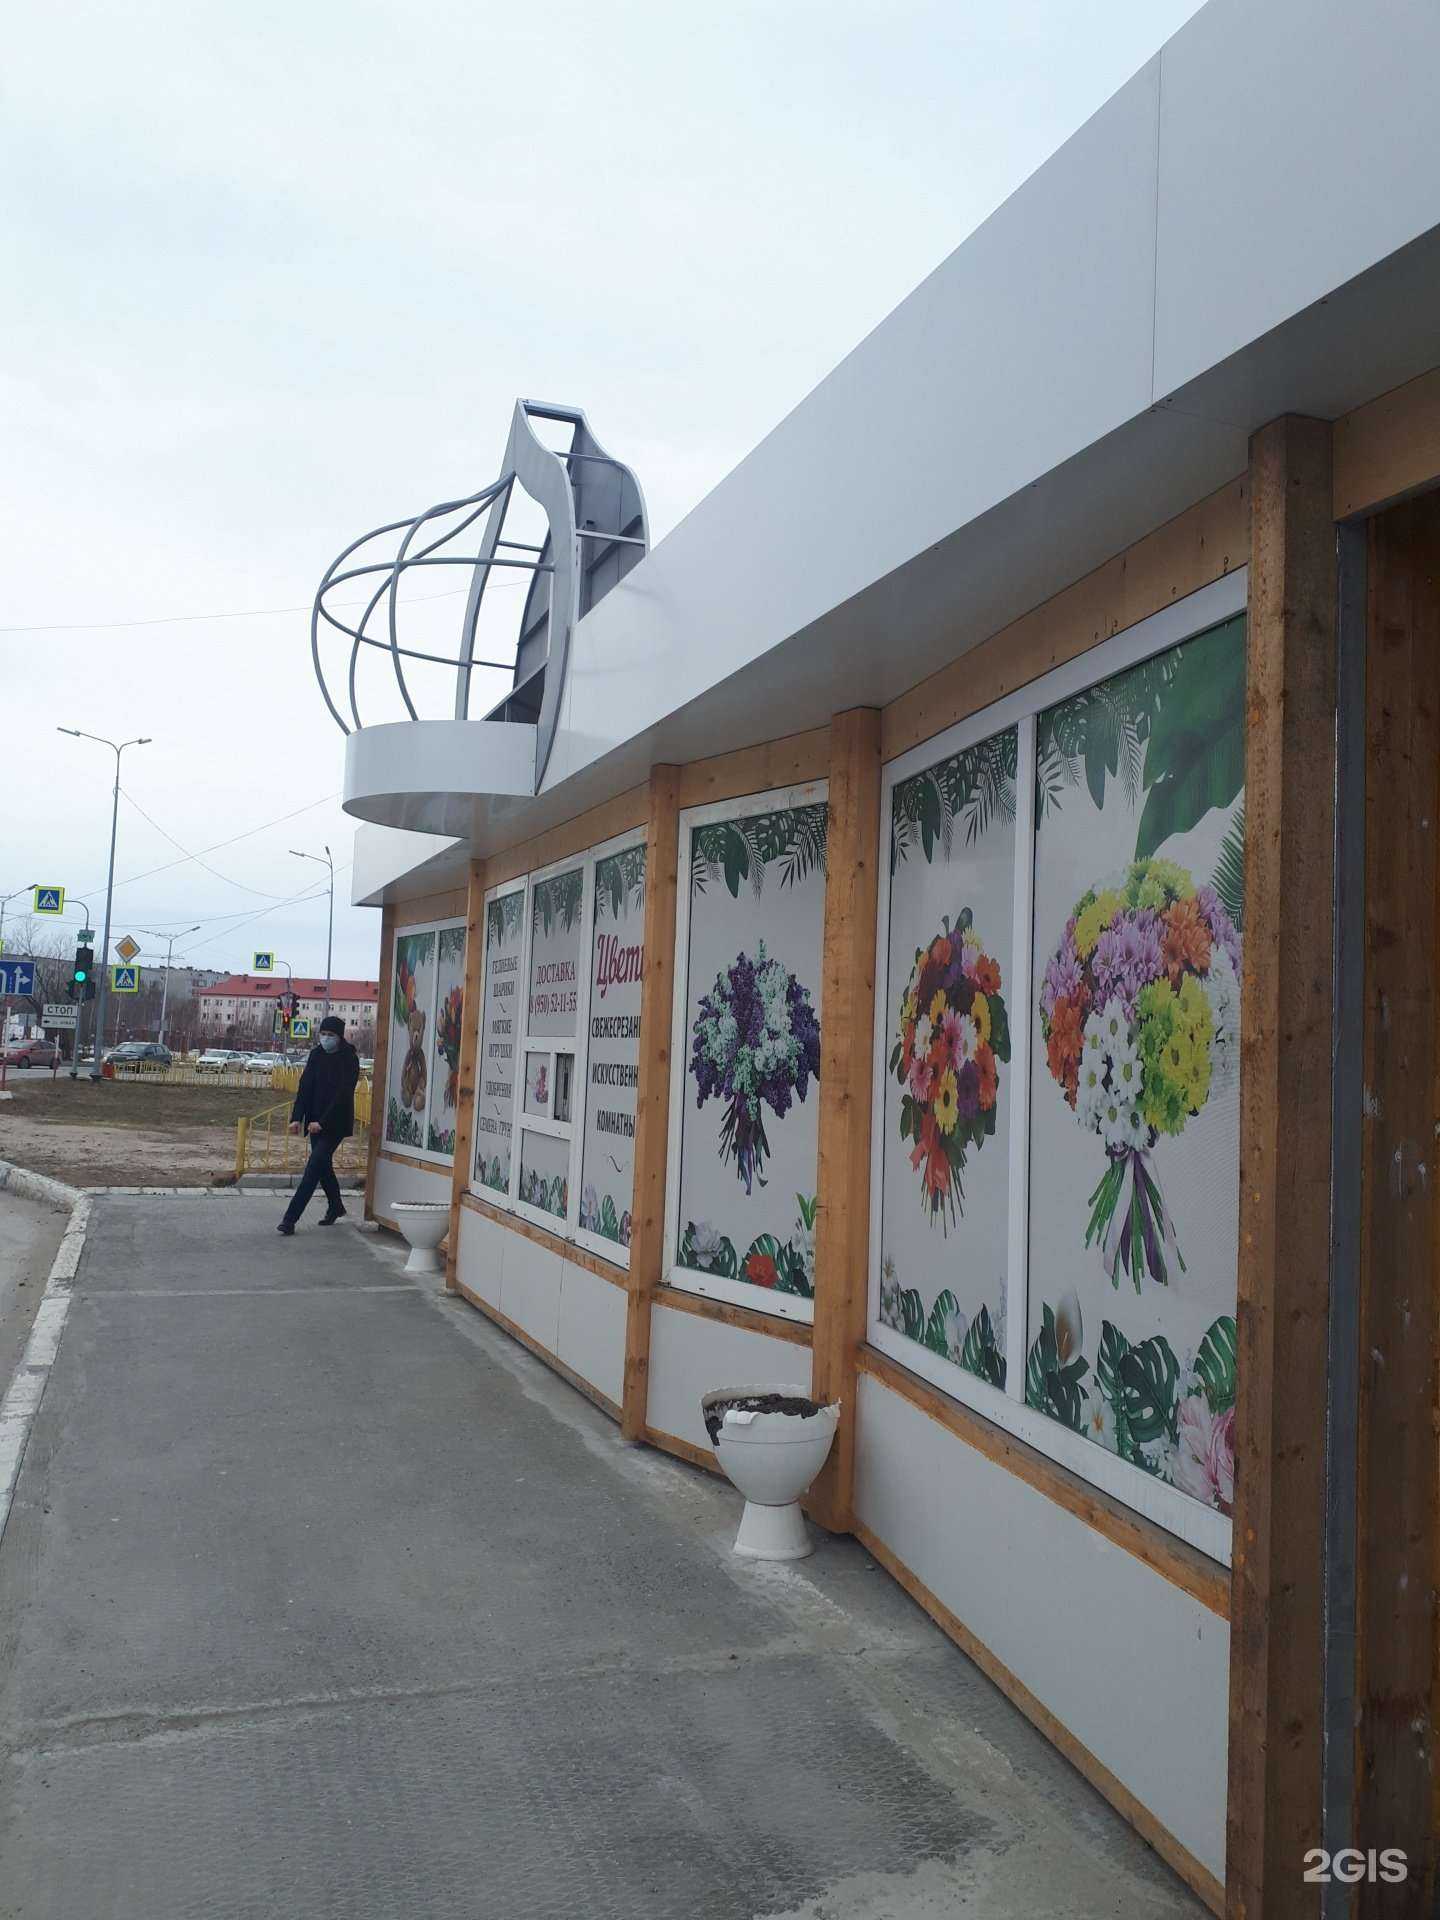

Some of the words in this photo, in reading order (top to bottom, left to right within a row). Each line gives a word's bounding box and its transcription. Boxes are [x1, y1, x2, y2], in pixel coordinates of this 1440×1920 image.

[536, 961, 576, 987] ДОСТАВКА
[47, 1006, 73, 1015] СТОП
[592, 1063, 639, 1088] ИСКУССТВЕНН
[597, 1109, 636, 1138] КОМНАТНЫ
